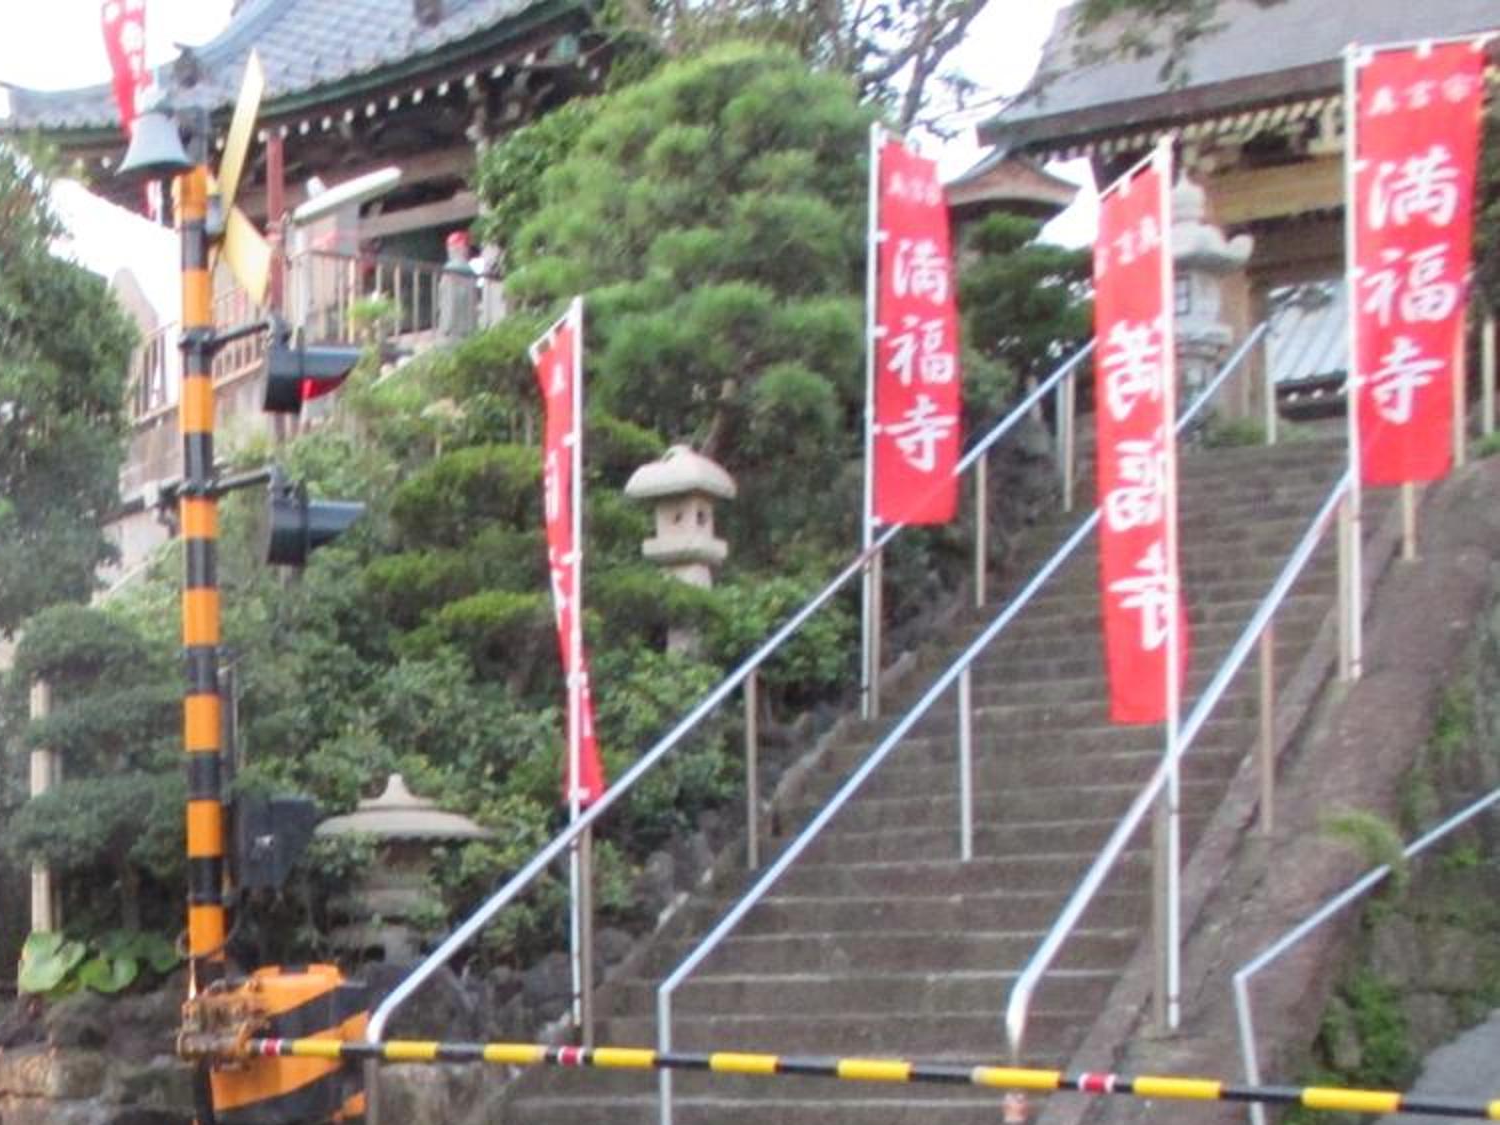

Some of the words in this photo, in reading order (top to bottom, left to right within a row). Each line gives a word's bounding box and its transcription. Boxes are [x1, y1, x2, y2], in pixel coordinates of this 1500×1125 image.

[884, 240, 956, 472] 満福寺
[1364, 144, 1460, 424] 満福寺
